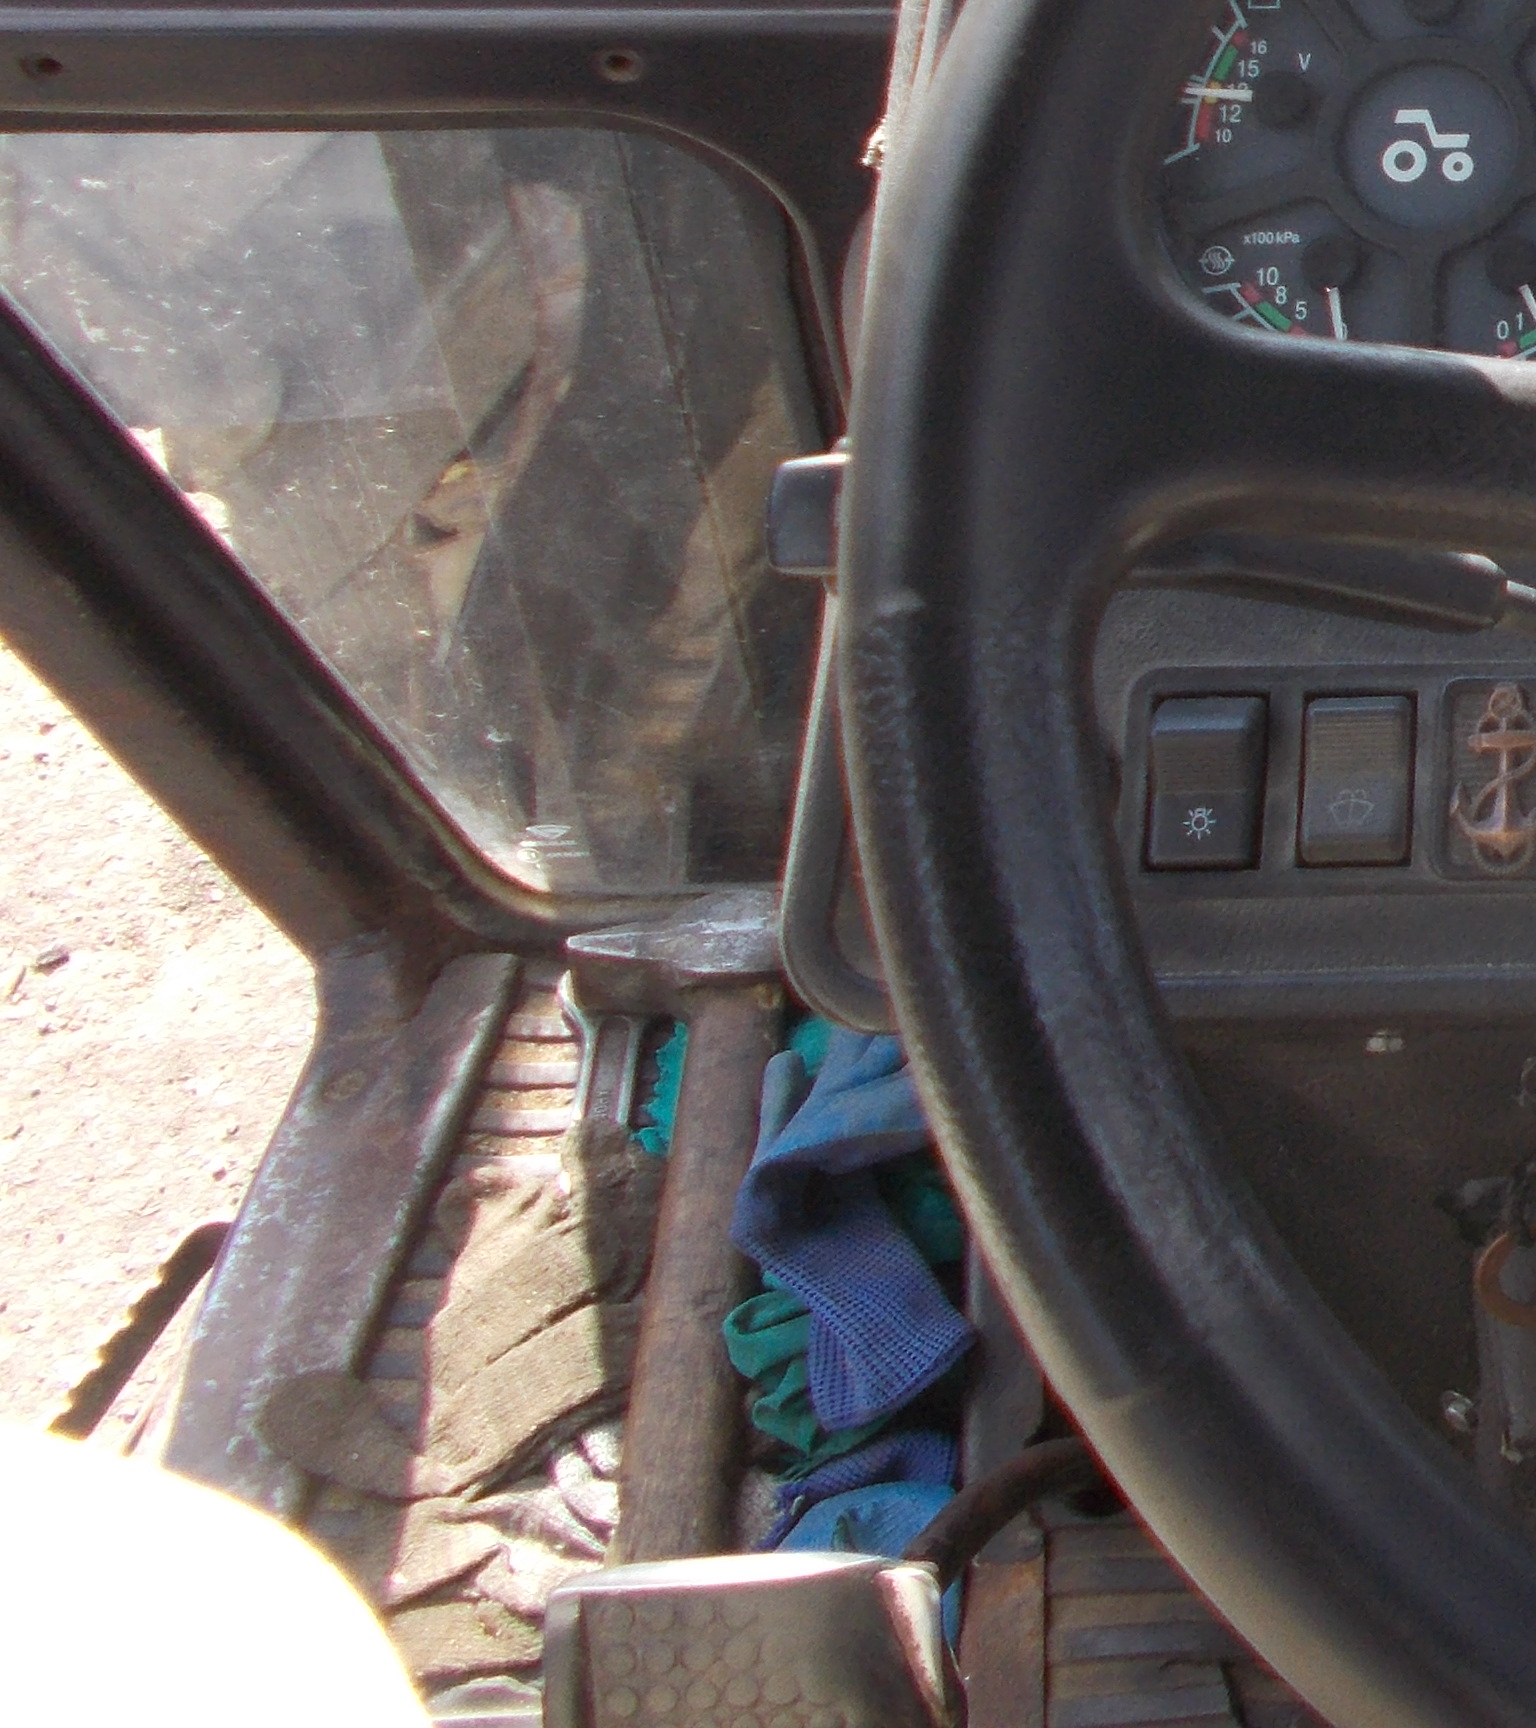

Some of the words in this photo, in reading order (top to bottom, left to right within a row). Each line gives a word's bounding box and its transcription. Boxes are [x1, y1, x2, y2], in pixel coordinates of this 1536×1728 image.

[1250, 39, 1268, 55] 16
[1237, 59, 1260, 78] 15
[1297, 53, 1311, 71] V
[1219, 104, 1242, 123] 12
[1214, 128, 1233, 144] 10
[1256, 266, 1279, 287] 10
[1274, 285, 1288, 305] 8
[1294, 300, 1308, 320] 5
[1496, 320, 1510, 340] 0
[1515, 311, 1524, 331] 1
